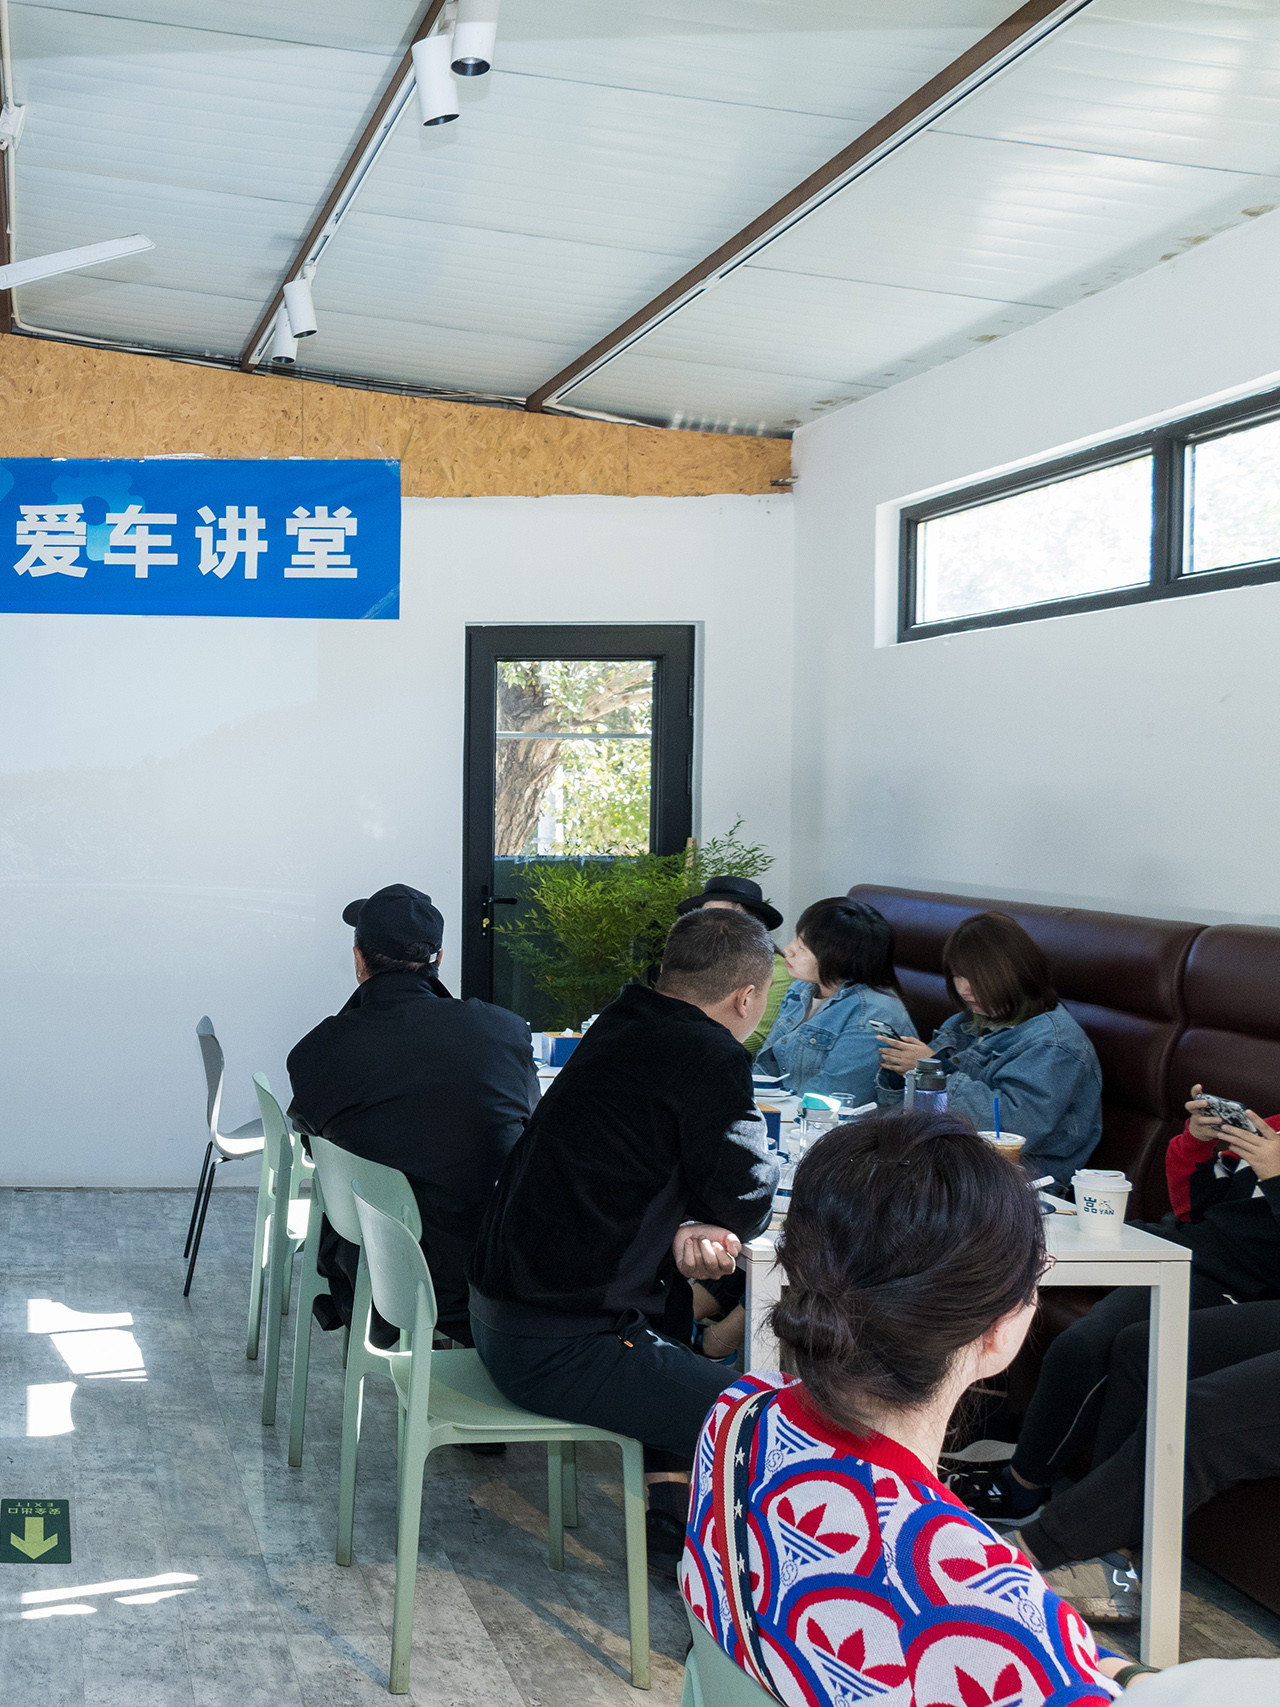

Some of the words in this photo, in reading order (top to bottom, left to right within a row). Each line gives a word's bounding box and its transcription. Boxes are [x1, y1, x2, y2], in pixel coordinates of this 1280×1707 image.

[13, 503, 358, 580] 爱车讲堂
[1099, 1208, 1115, 1216] YAN
[8, 1507, 61, 1515] 安全出口
